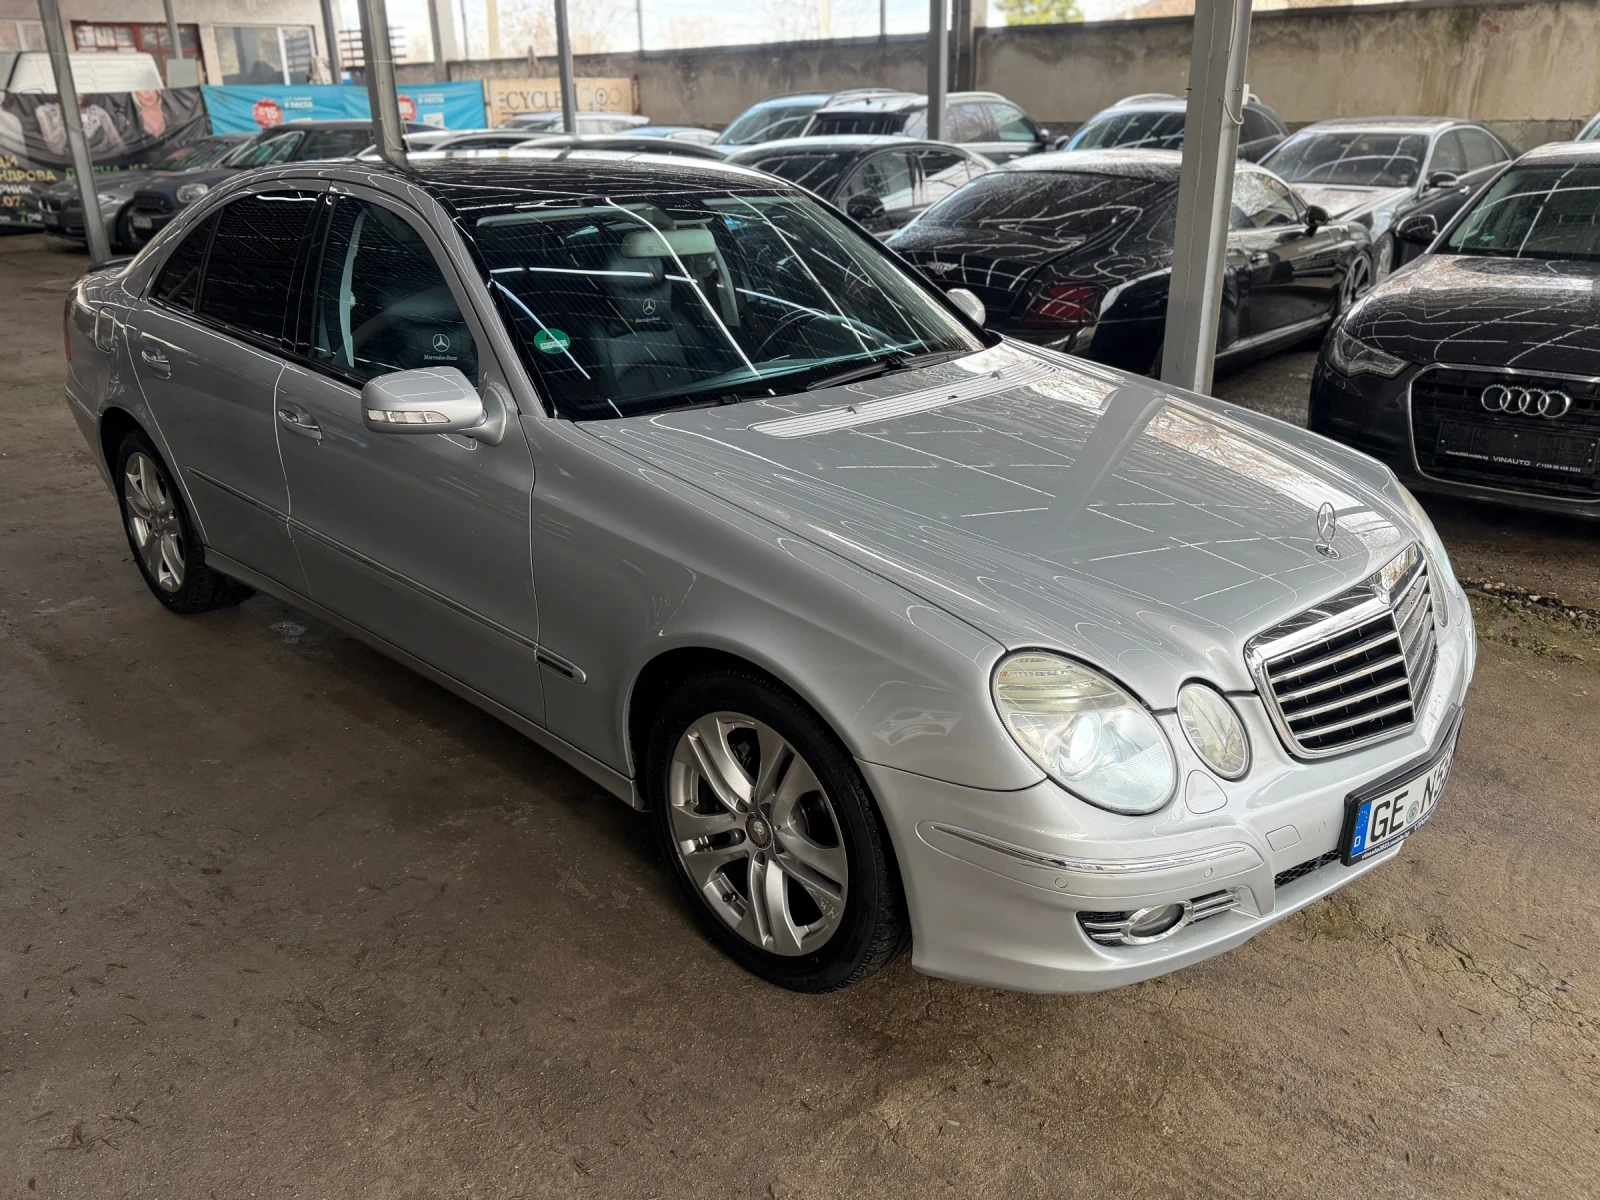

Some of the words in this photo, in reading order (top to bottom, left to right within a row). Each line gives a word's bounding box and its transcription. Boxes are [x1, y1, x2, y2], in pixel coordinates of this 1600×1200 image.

[1492, 455, 1531, 467] VINAUTO
[1353, 835, 1361, 848] D
[1370, 790, 1409, 843] GE
